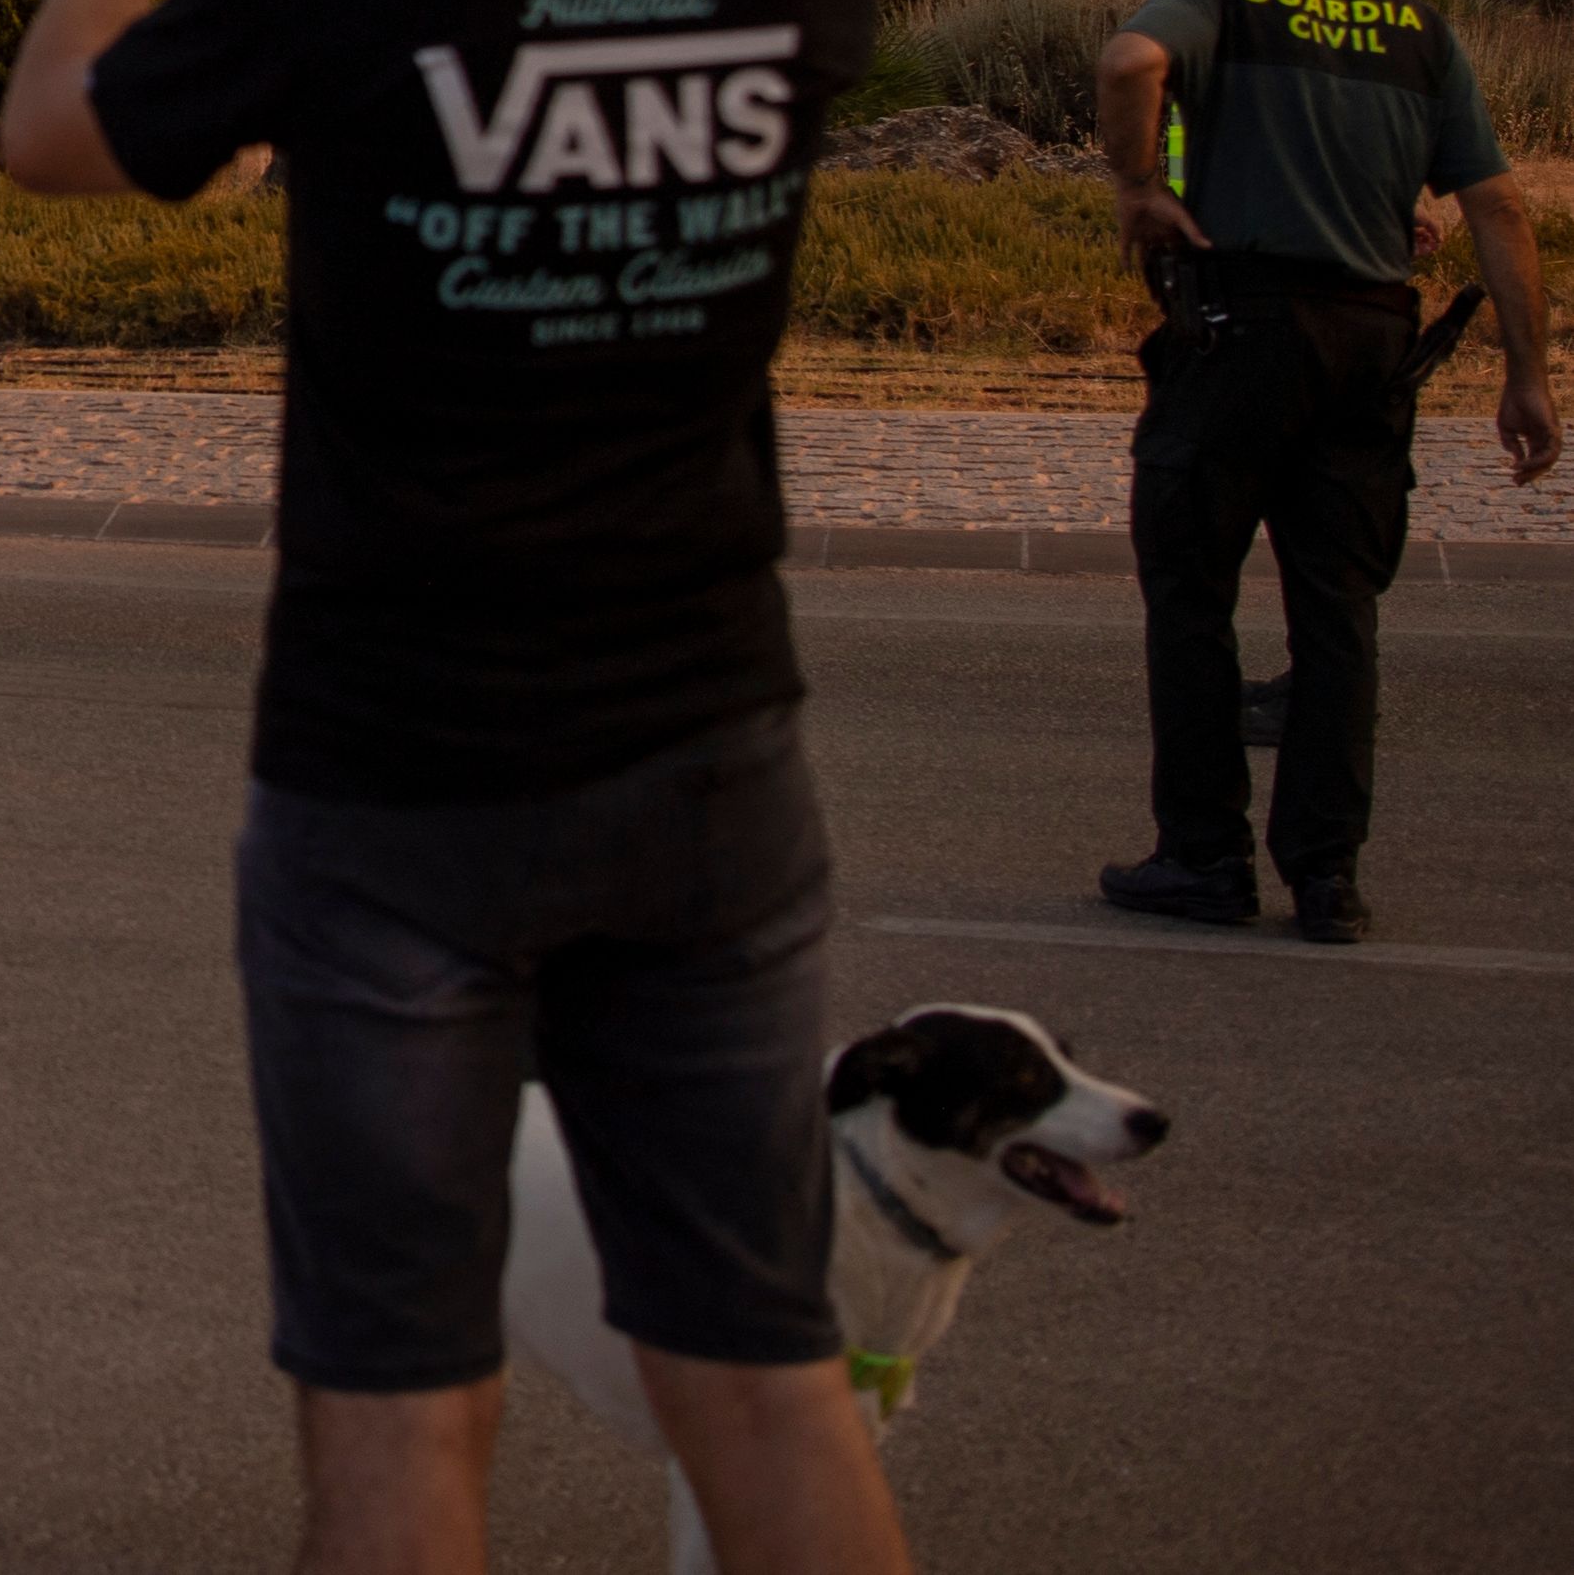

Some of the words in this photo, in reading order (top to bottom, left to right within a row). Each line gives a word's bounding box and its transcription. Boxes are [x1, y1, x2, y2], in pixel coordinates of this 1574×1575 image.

[1288, 13, 1387, 54] CIVIL
[413, 25, 800, 194] VANS
[555, 200, 657, 253] THE
